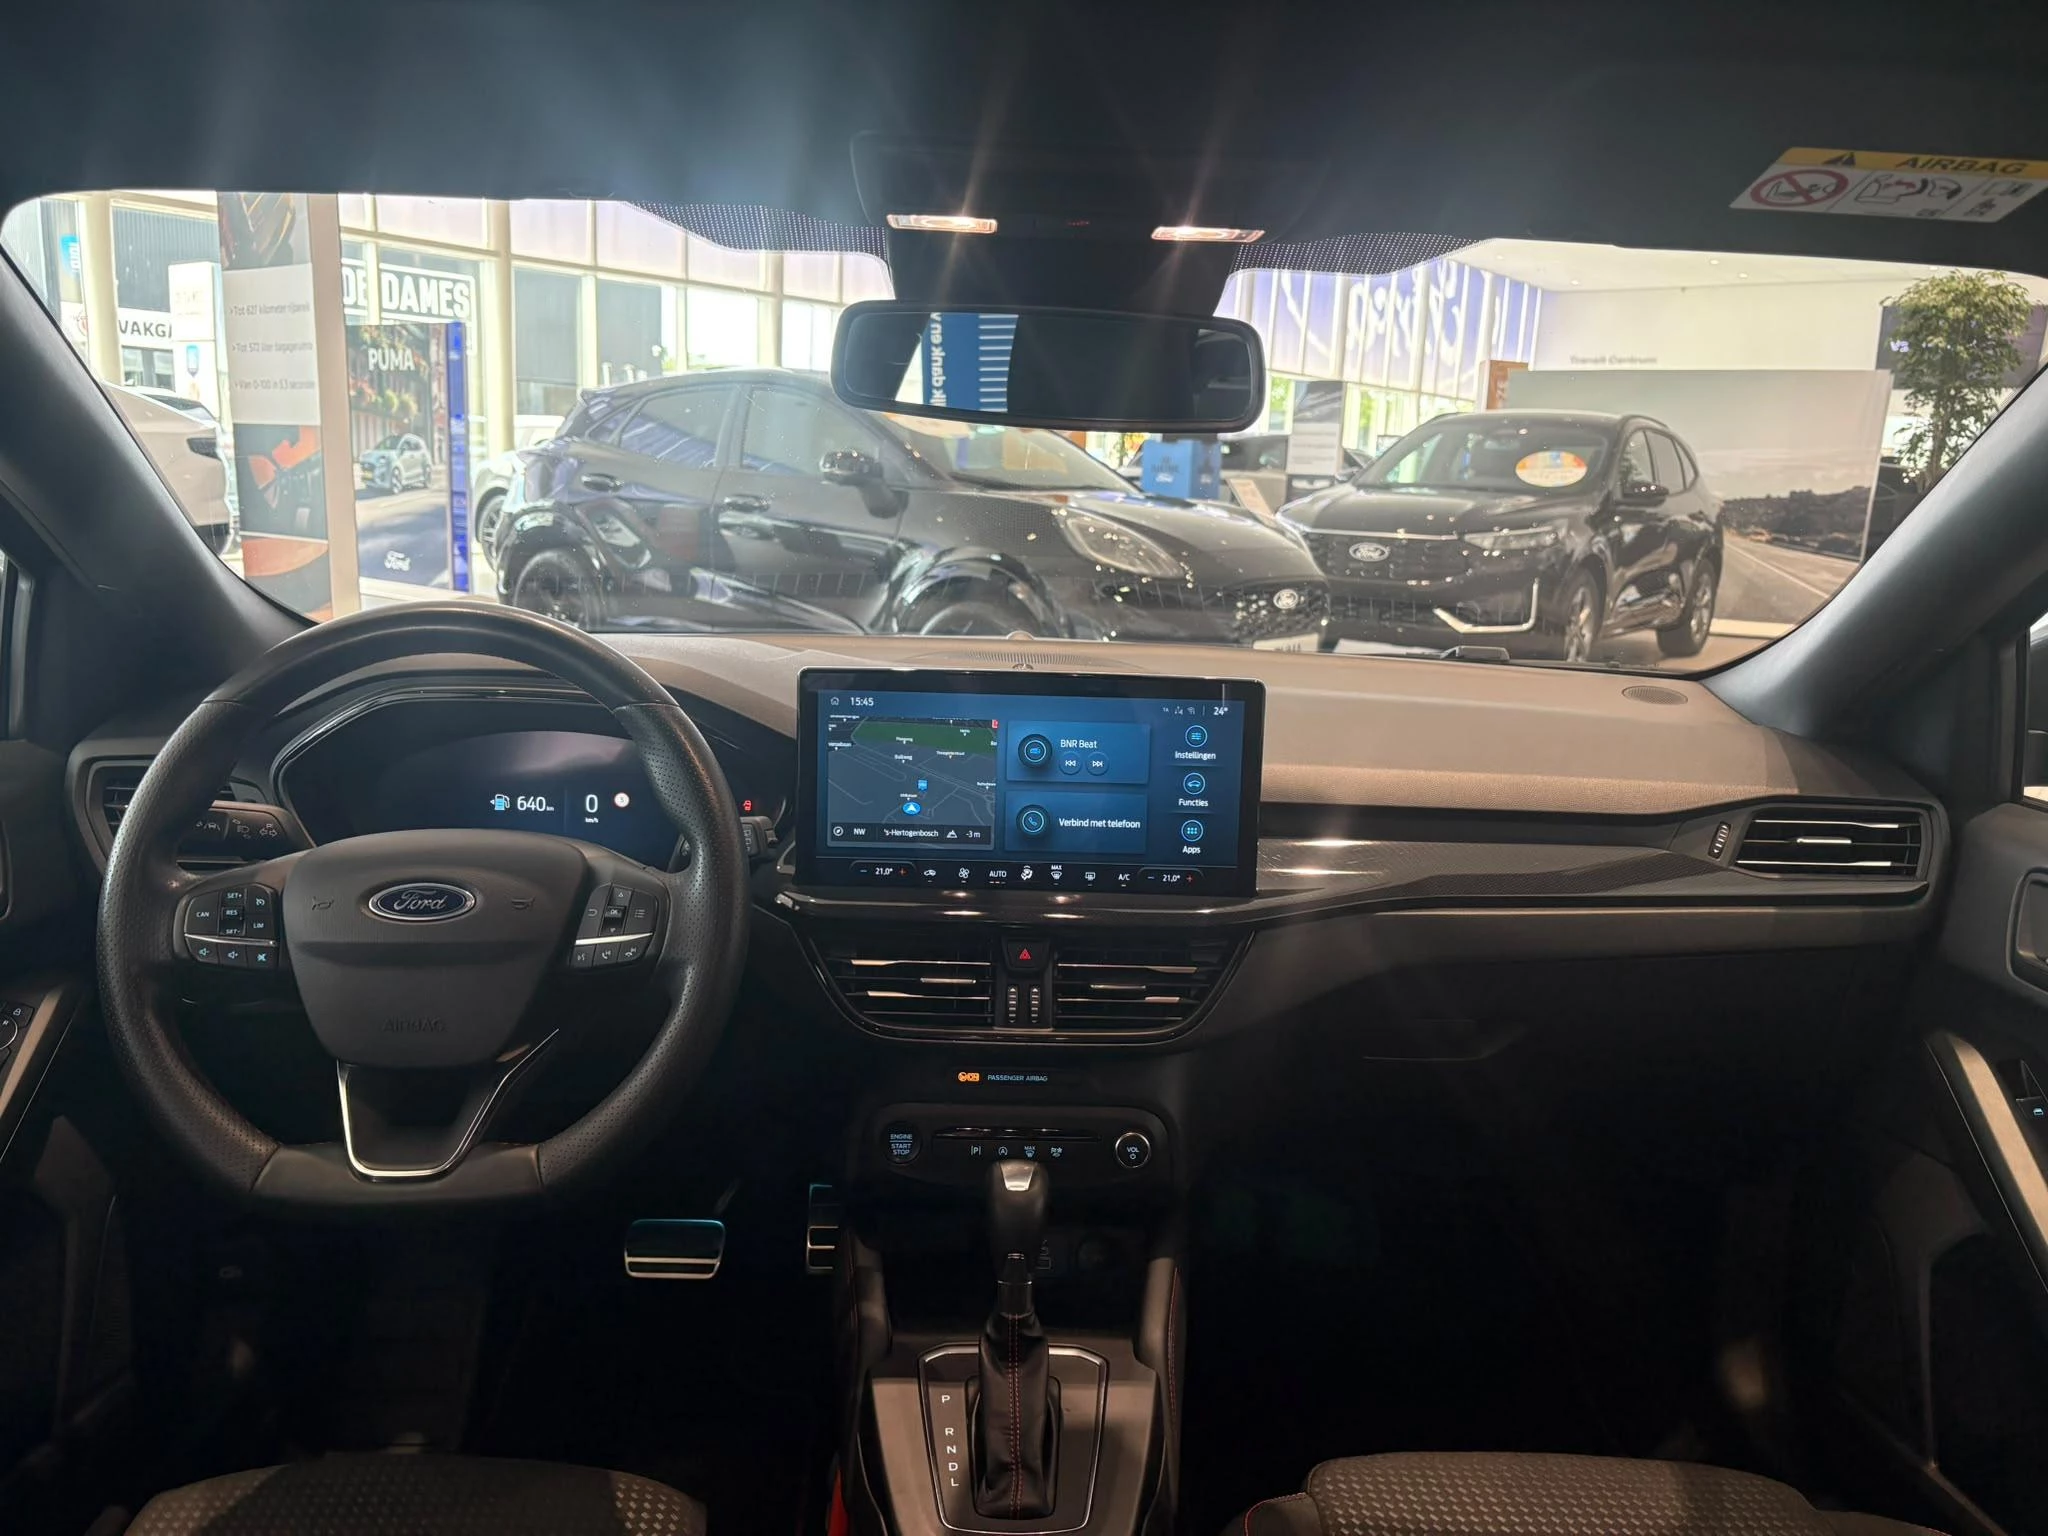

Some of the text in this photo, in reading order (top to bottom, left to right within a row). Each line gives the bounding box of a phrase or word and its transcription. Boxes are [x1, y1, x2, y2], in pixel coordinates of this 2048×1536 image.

[1895, 156, 2028, 174] AIRBAG
[341, 266, 471, 319] DE DAMES
[368, 347, 416, 371] PUMA
[850, 697, 874, 706] 15:45
[1060, 739, 1097, 749] BNR Beat
[1175, 751, 1216, 761] Instellingen
[517, 796, 546, 811] 640
[585, 794, 598, 813] 0
[1178, 799, 1209, 807] Functies
[1059, 818, 1141, 828] Verbind met telefoon
[883, 828, 939, 838] 's-Hertogenbosch
[1182, 846, 1201, 855] Apps
[393, 889, 448, 910] Ford
[382, 1016, 446, 1034] AIRBAG
[941, 1395, 950, 1403] P
[944, 1427, 954, 1436] R
[946, 1445, 957, 1454] N
[948, 1462, 958, 1472] D
[950, 1478, 959, 1487] L
